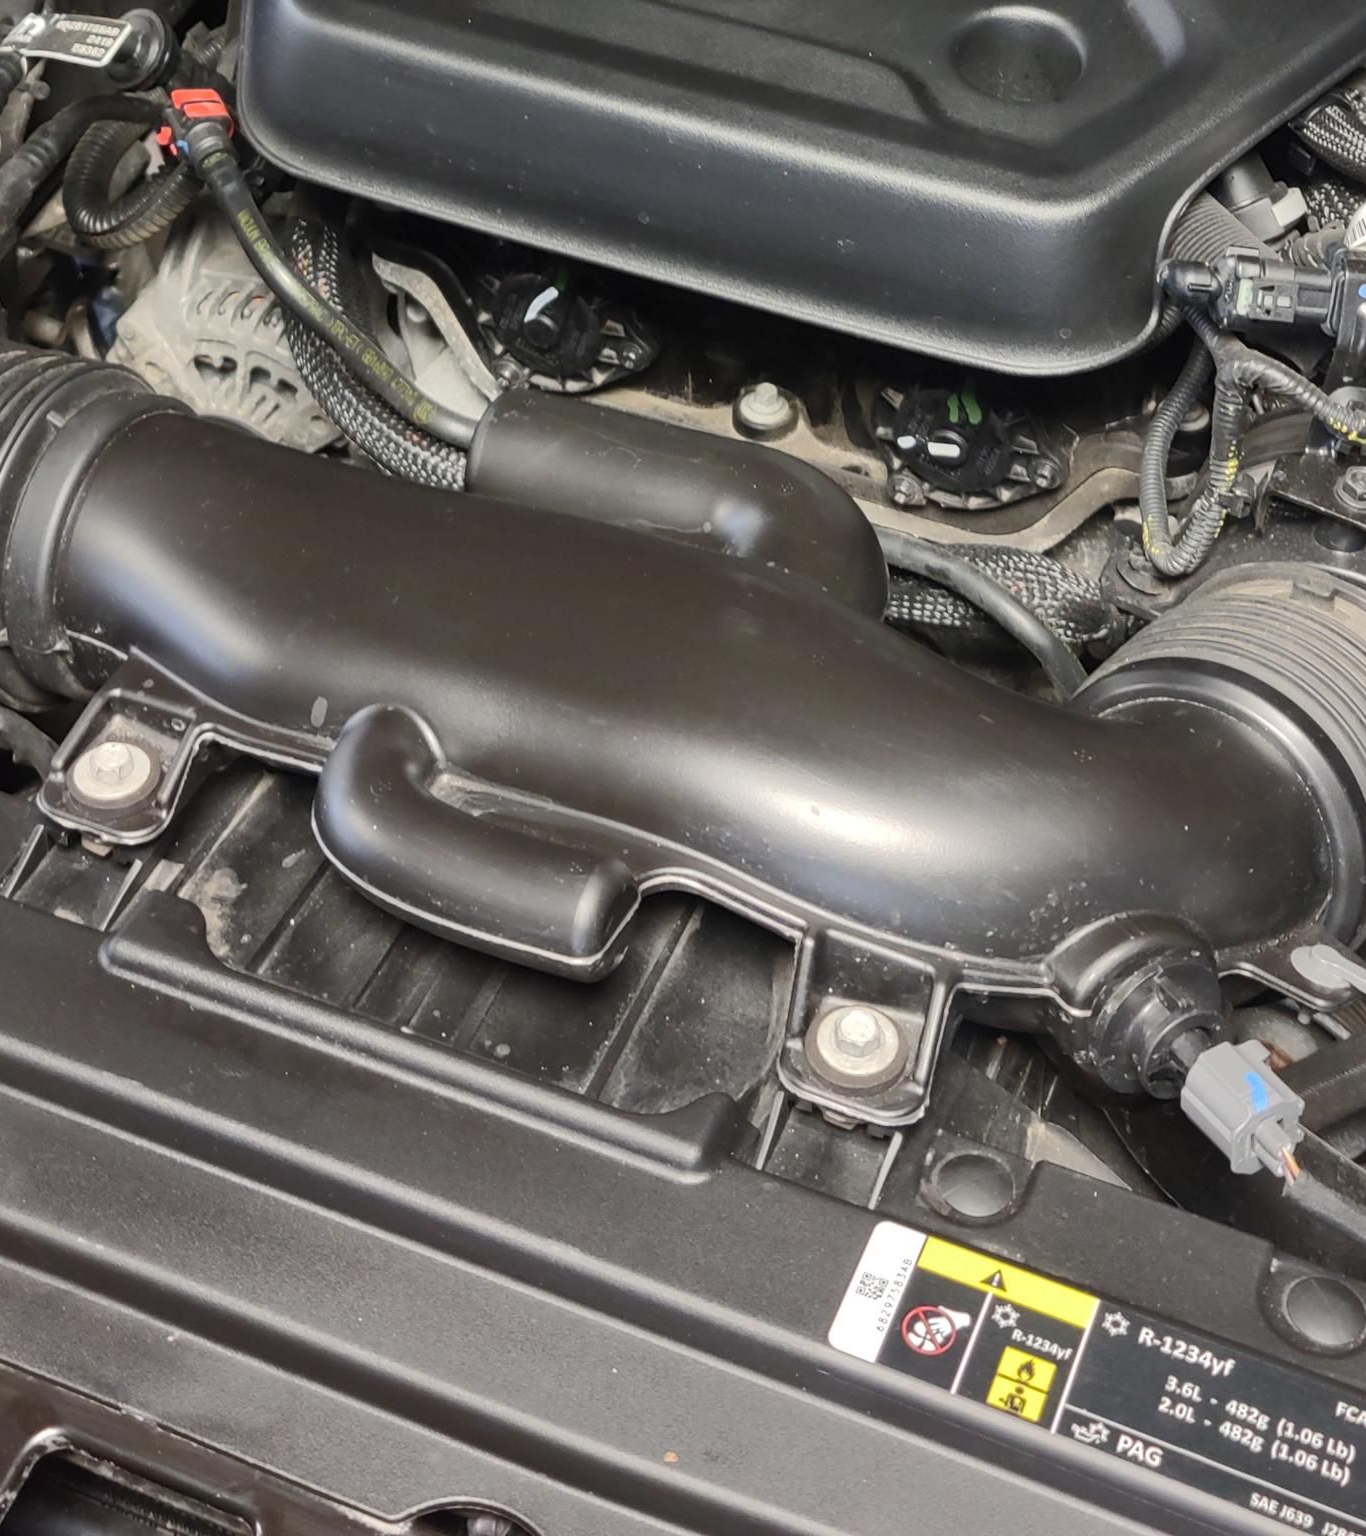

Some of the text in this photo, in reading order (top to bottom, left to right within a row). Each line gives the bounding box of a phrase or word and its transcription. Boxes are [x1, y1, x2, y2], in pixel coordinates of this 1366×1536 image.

[875, 1257, 913, 1332] 68297583AB
[1010, 1326, 1073, 1361] R-1234yf
[1137, 1326, 1236, 1377] R-1234yf
[1157, 1396, 1196, 1425] 2.0L
[1218, 1420, 1265, 1454] 482g
[1270, 1439, 1318, 1471] (1.06
[1321, 1457, 1352, 1488] Lb)
[1164, 1374, 1203, 1403] 3.6L
[1225, 1398, 1271, 1432] 482g
[1276, 1417, 1324, 1450] (1.06
[1327, 1435, 1357, 1465] Lb)
[1116, 1433, 1164, 1468] PAG
[1249, 1491, 1365, 1536] SAE J639 J28
